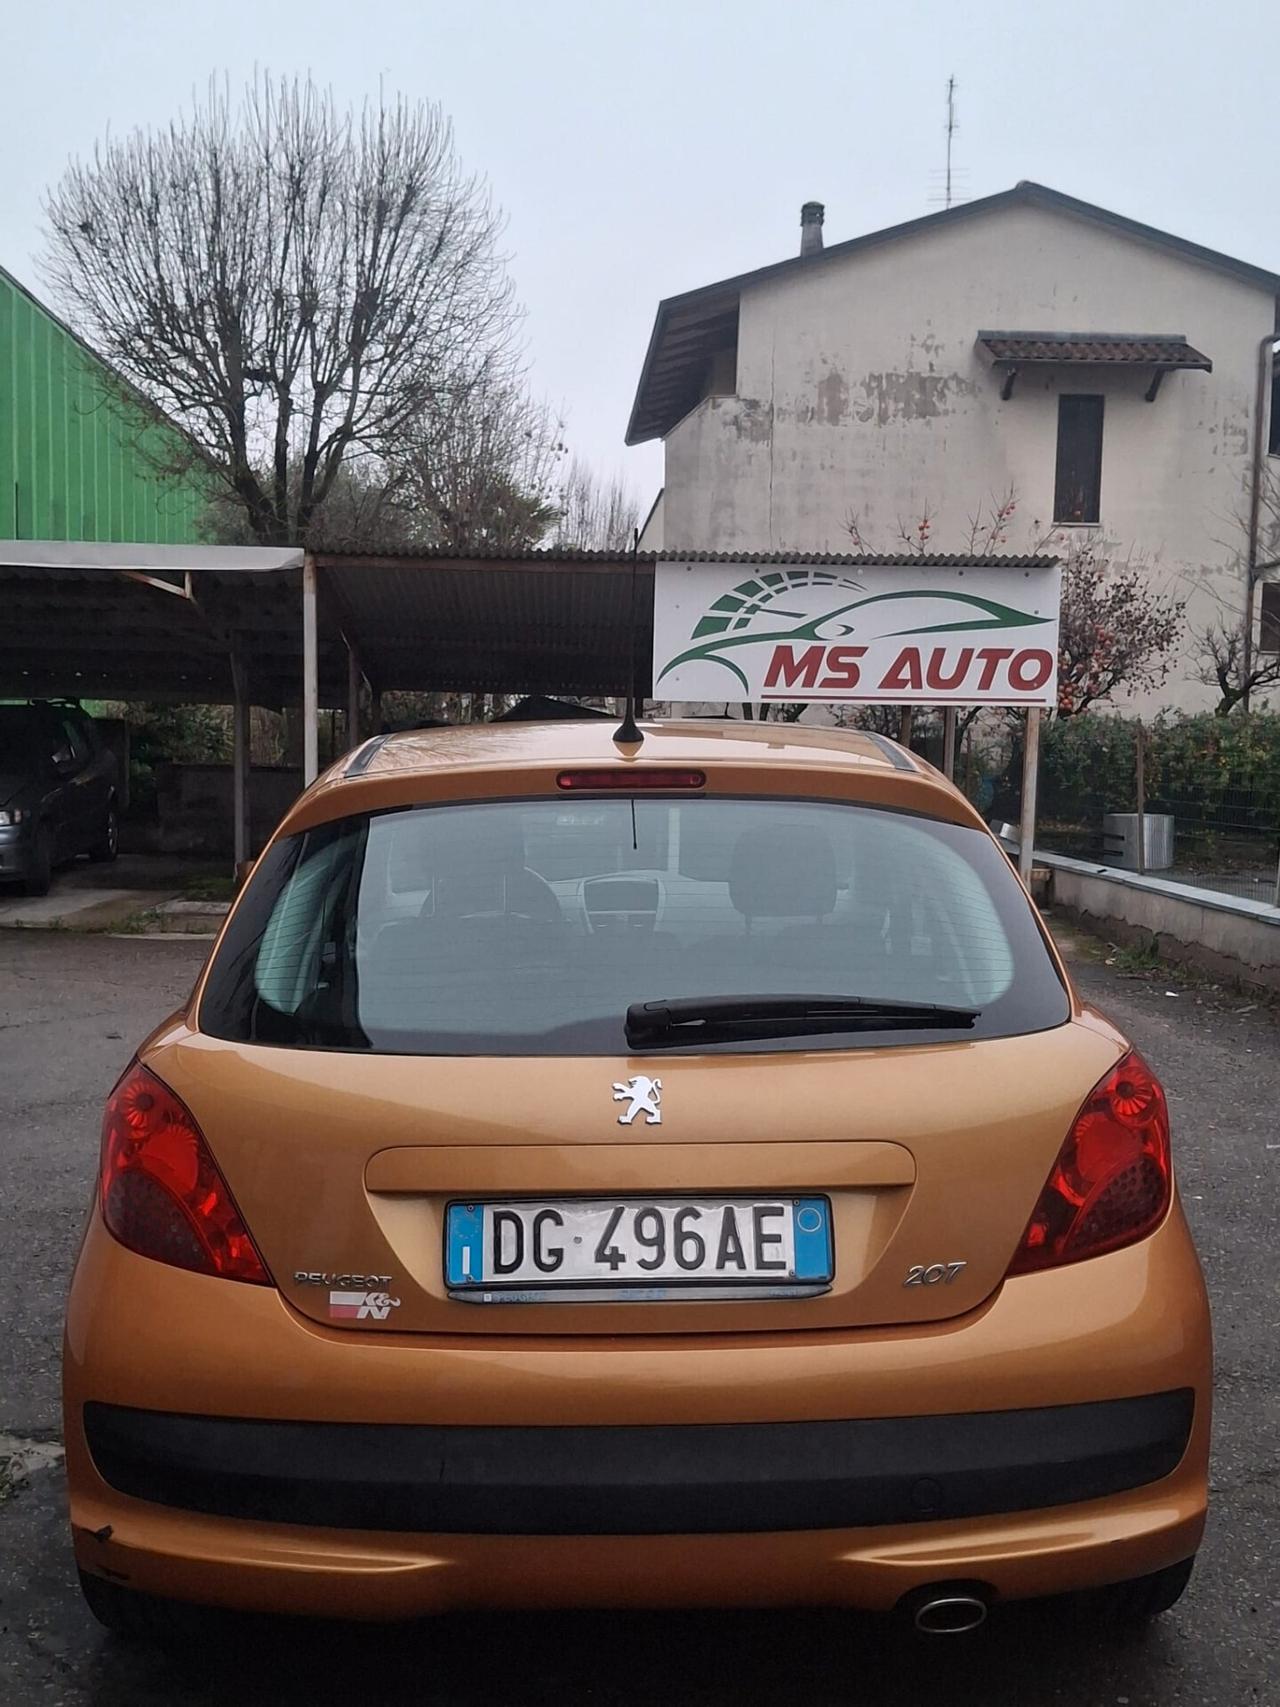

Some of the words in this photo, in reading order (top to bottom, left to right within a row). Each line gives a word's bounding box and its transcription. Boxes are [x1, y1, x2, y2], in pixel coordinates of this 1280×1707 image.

[763, 645, 869, 689] MS
[878, 647, 1054, 692] AUTO
[493, 1208, 565, 1275] DG
[594, 1205, 787, 1271] 496AE
[293, 1271, 393, 1288] PEUGEOT
[903, 1261, 967, 1287] 207
